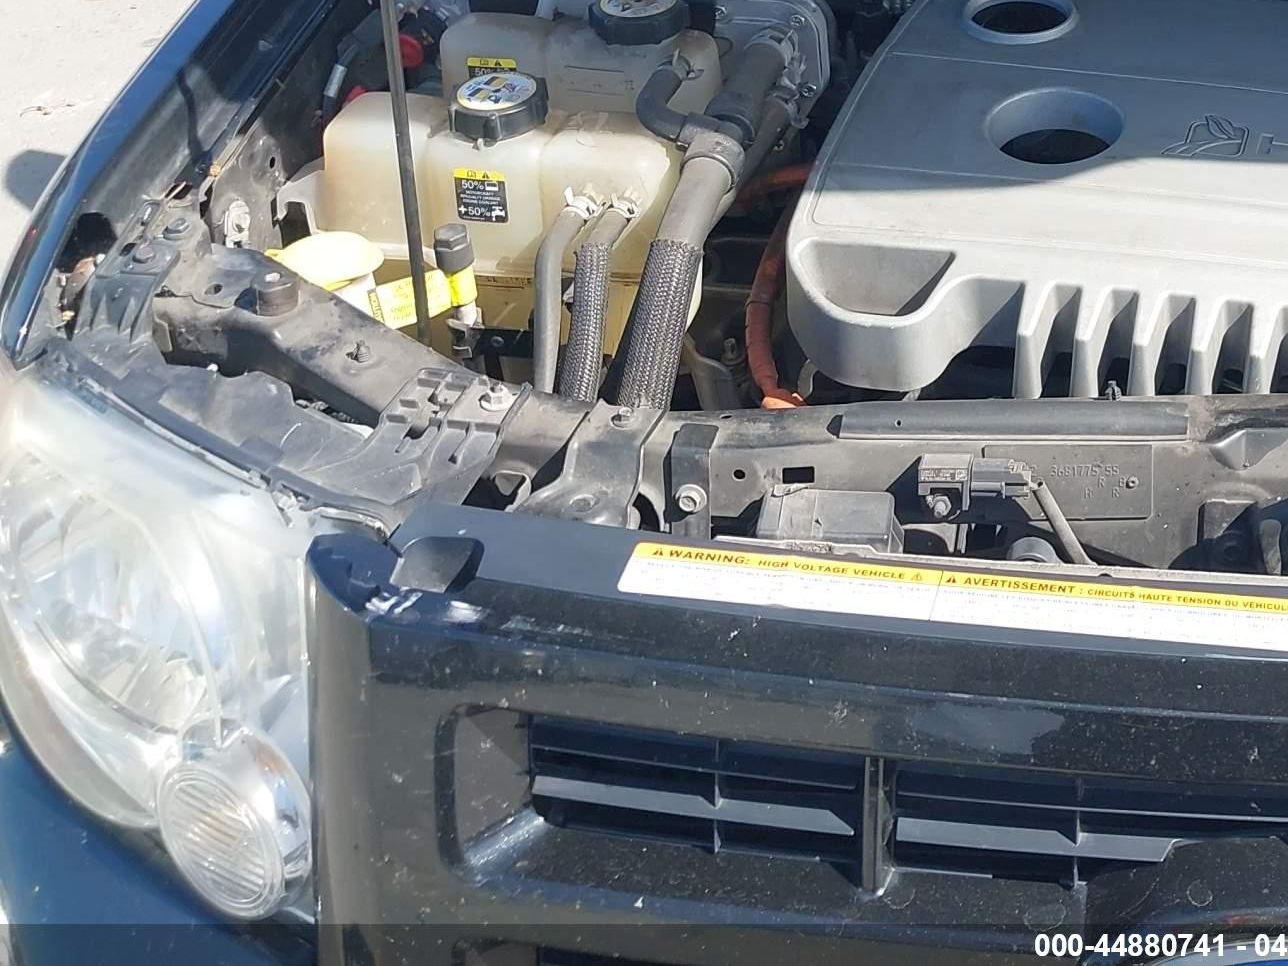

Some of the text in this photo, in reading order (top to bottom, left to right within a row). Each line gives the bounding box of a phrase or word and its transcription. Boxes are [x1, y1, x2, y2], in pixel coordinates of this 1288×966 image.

[461, 179, 485, 190] 50%
[668, 549, 906, 581] WARNING: HIGH VOLTAGE VEHICLE
[963, 576, 1075, 595] AVERTISSEMENT
[1087, 588, 1135, 598] CIRCUITS
[1138, 592, 1173, 603] HAUTE
[1176, 595, 1221, 604] TENSION
